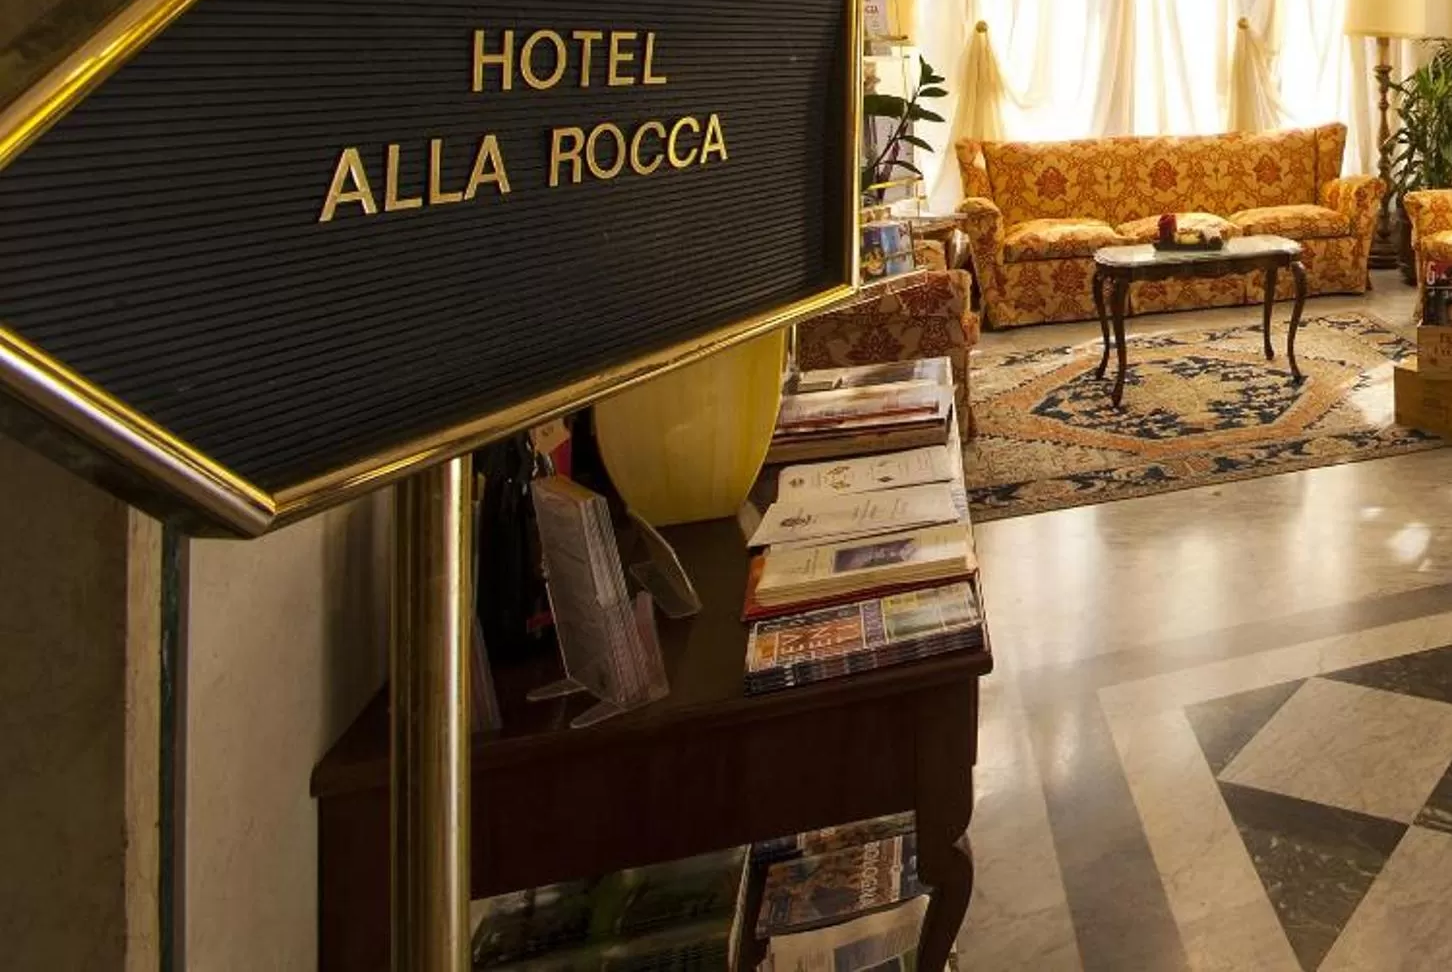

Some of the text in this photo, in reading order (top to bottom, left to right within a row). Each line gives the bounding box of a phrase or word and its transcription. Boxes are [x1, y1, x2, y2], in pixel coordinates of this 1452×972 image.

[472, 29, 668, 92] HOTEL
[318, 113, 729, 222] ALLA ROCCA
